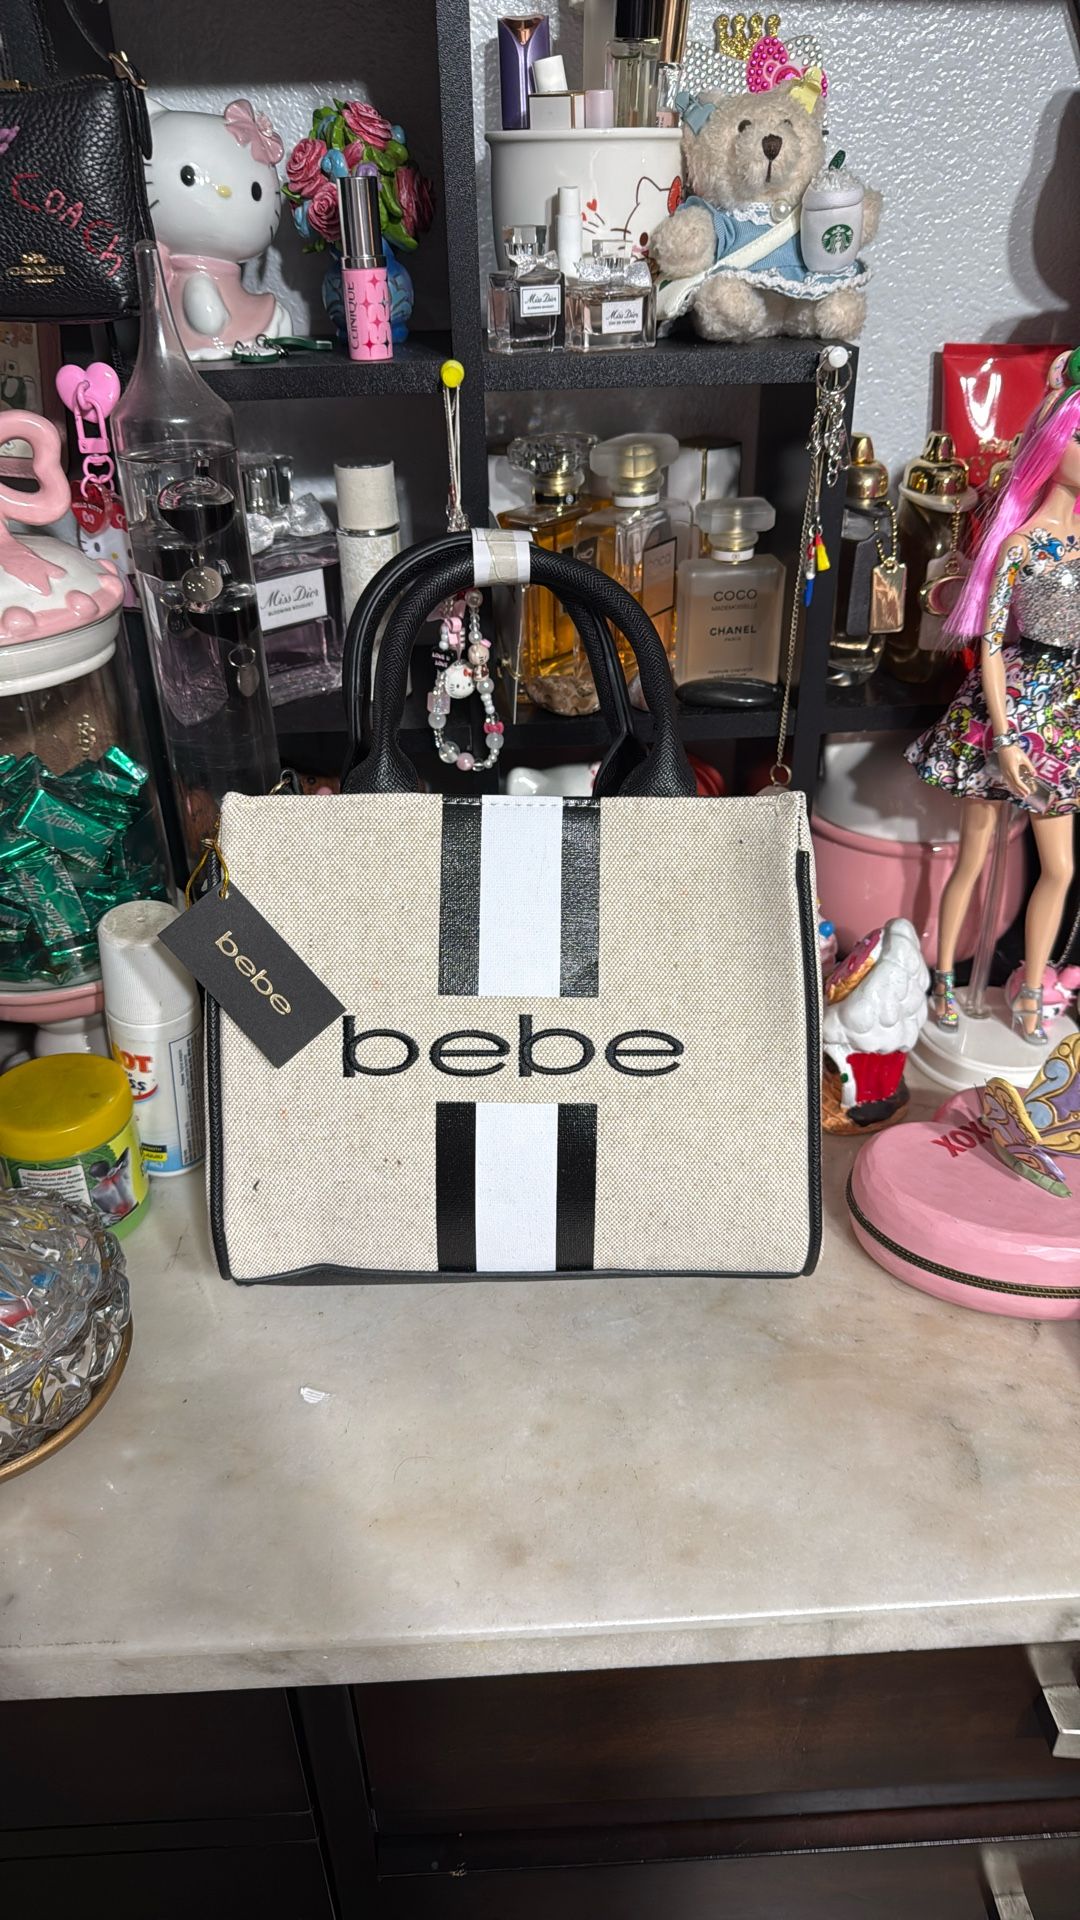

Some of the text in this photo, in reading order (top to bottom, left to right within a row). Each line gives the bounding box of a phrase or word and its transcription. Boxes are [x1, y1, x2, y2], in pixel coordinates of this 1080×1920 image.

[543, 292, 557, 302] Dior
[347, 281, 359, 350] CLINIQUE
[623, 309, 639, 319] Dior
[260, 585, 319, 610] Miss Dior
[713, 588, 758, 602] COCO
[709, 625, 757, 637] CHANEL
[215, 930, 291, 1015] bebe
[342, 1014, 684, 1077] bebe
